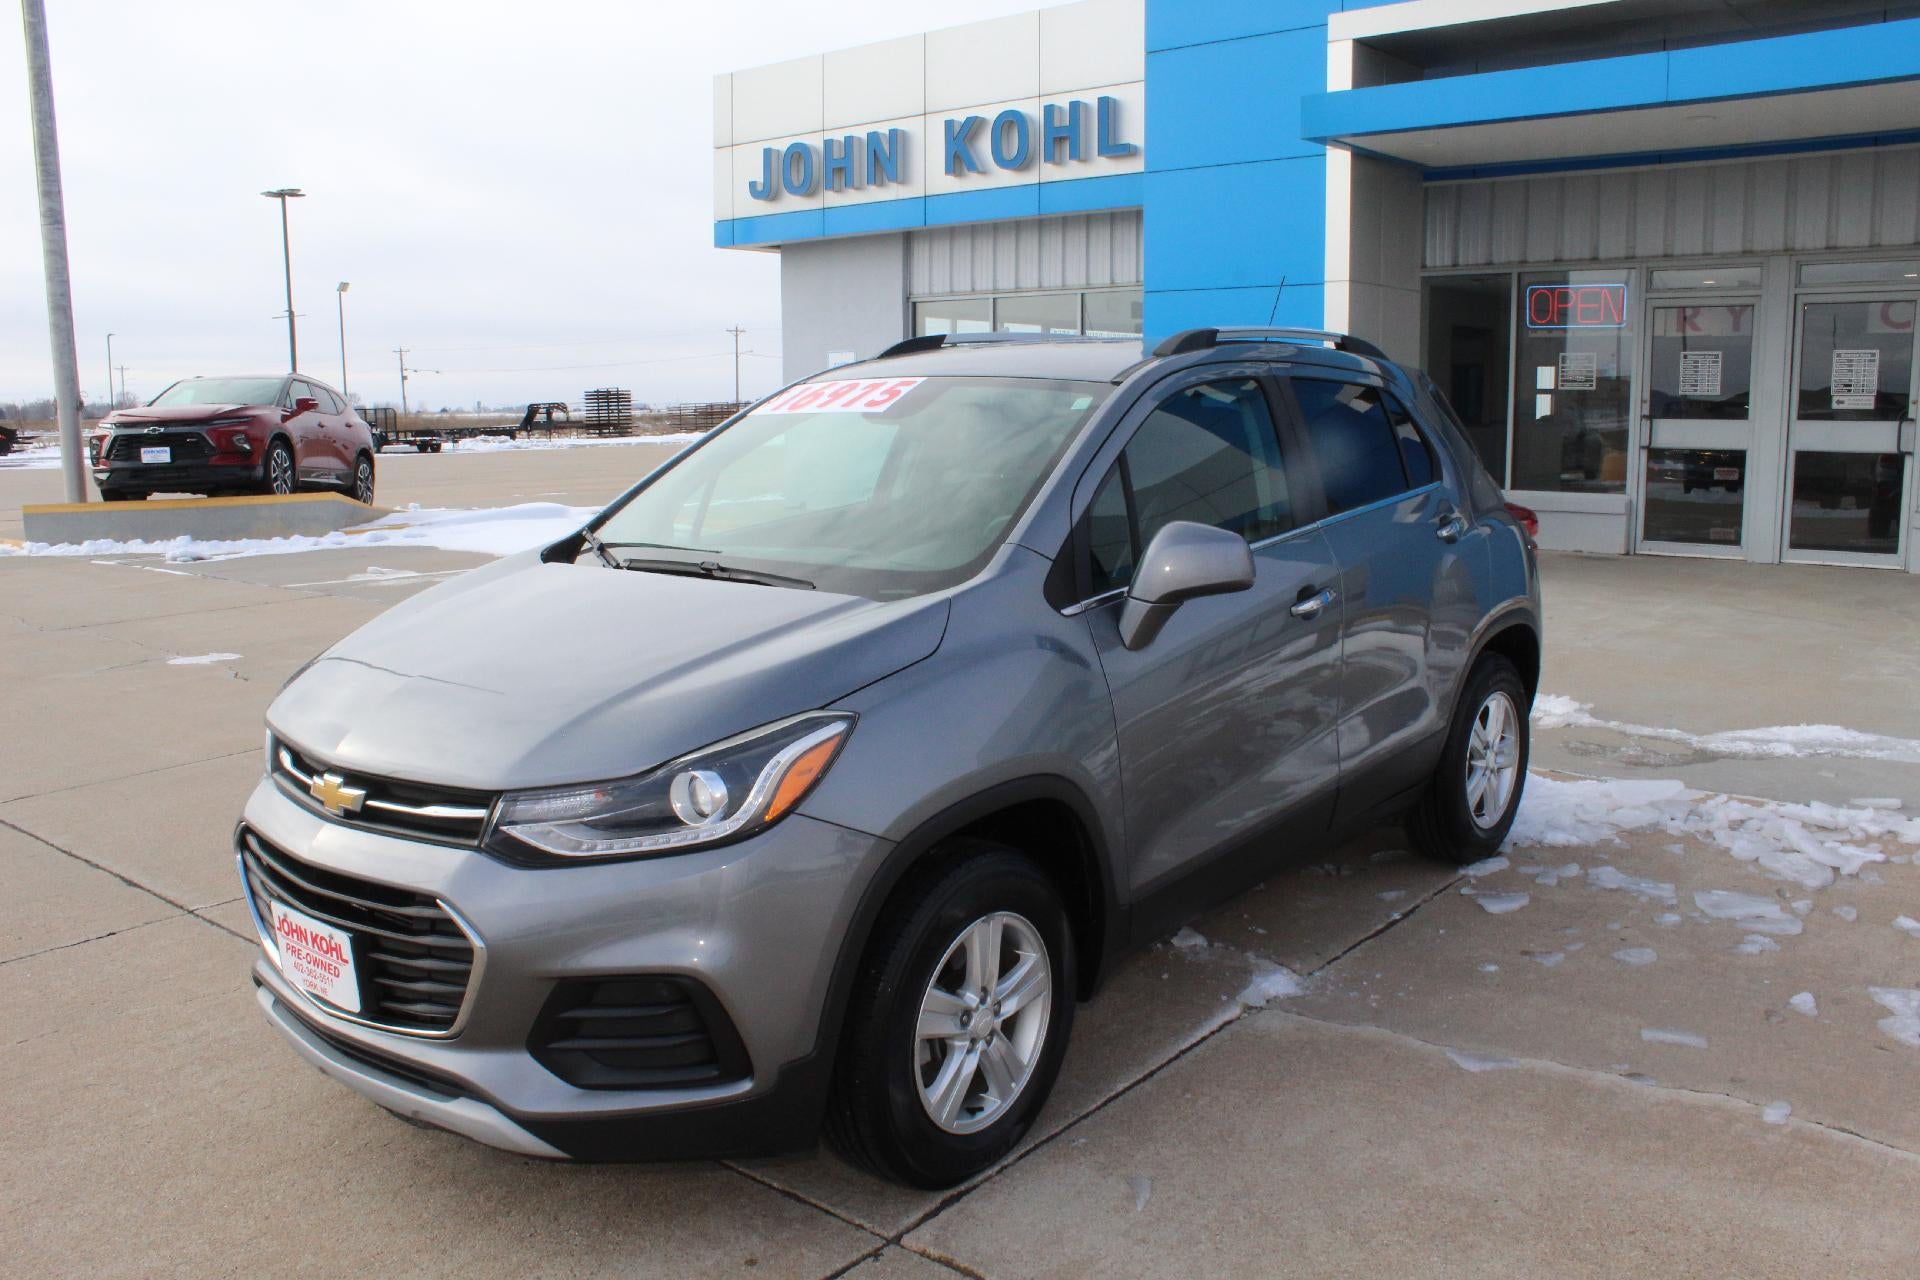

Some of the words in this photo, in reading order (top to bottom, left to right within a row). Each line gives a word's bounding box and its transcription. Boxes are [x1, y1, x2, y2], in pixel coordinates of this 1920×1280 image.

[749, 128, 905, 200] JOHN
[944, 95, 1138, 177] KOHL
[1530, 287, 1624, 324] OPEN
[277, 915, 309, 946] JOHN
[310, 930, 349, 965] KOHL
[286, 942, 341, 979] PRE-OWNED
